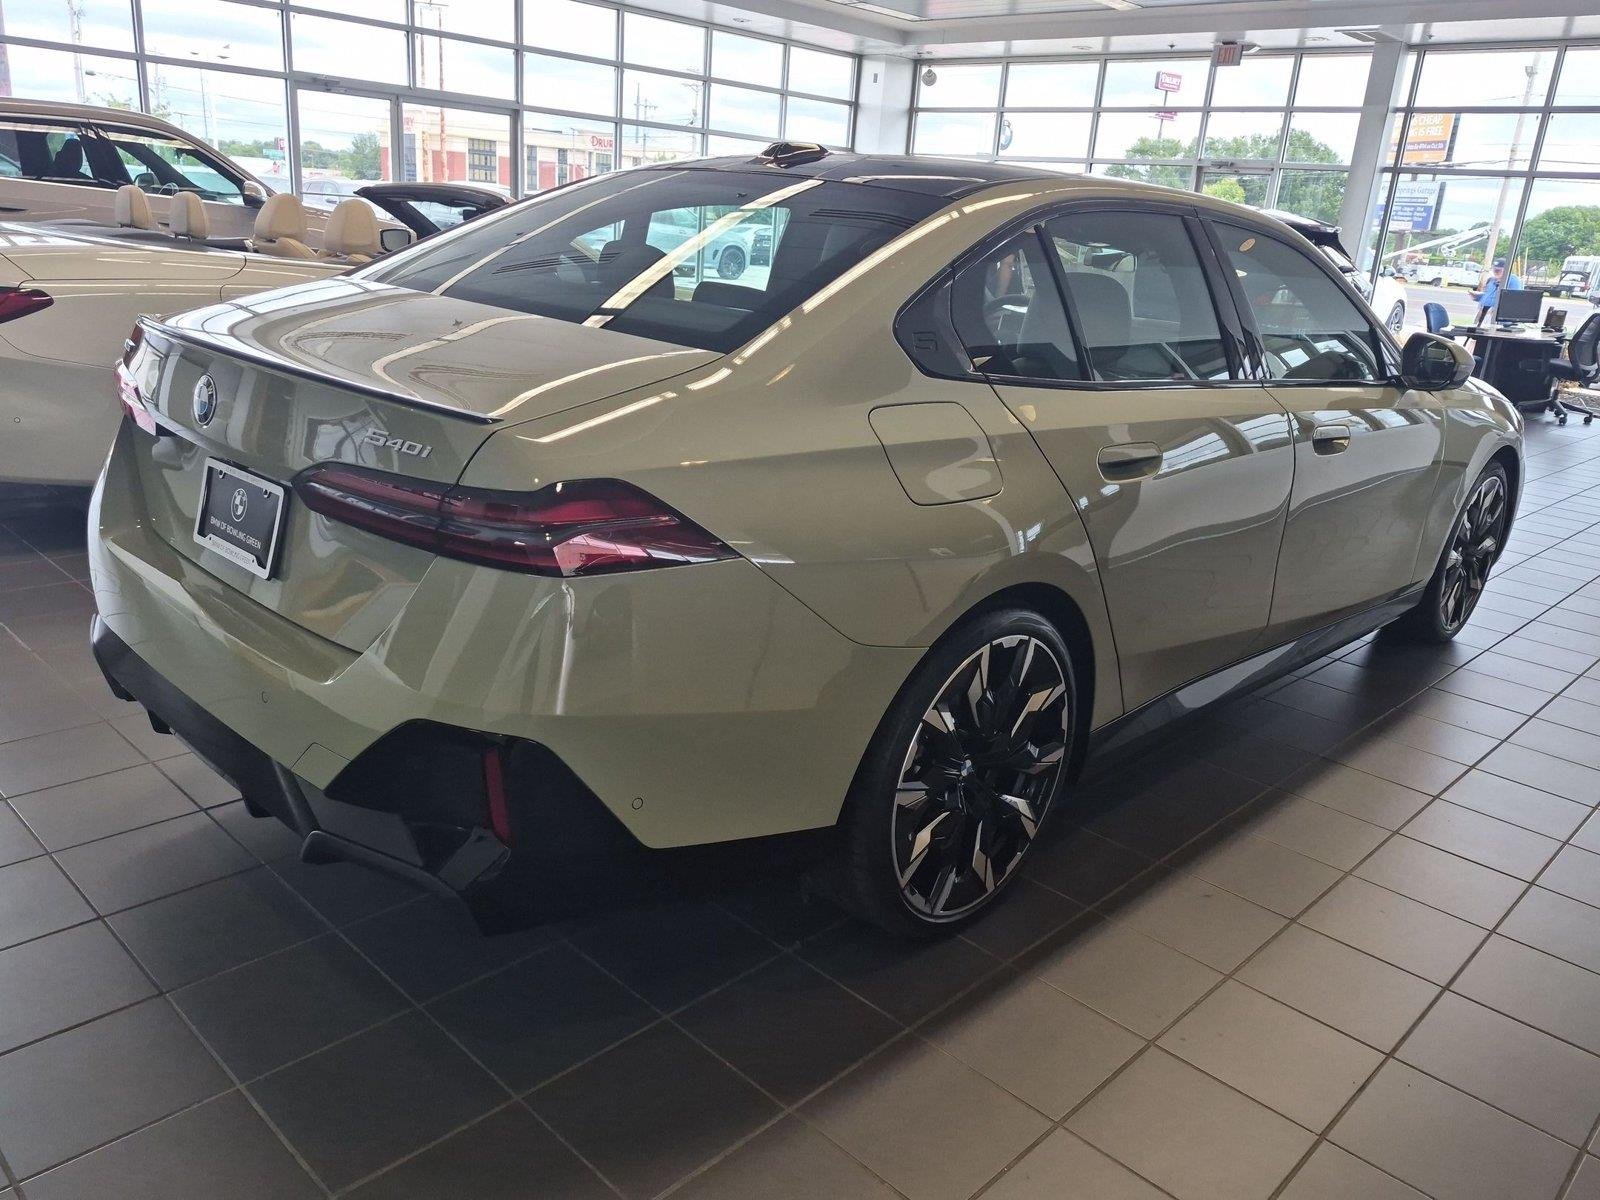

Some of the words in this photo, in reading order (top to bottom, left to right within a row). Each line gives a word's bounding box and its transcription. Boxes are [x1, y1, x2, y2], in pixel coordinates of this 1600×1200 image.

[591, 135, 614, 148] DRUR
[363, 427, 432, 458] 540i
[210, 516, 220, 527] BMW
[226, 524, 247, 542] BOWLING
[245, 534, 261, 549] GREEN
